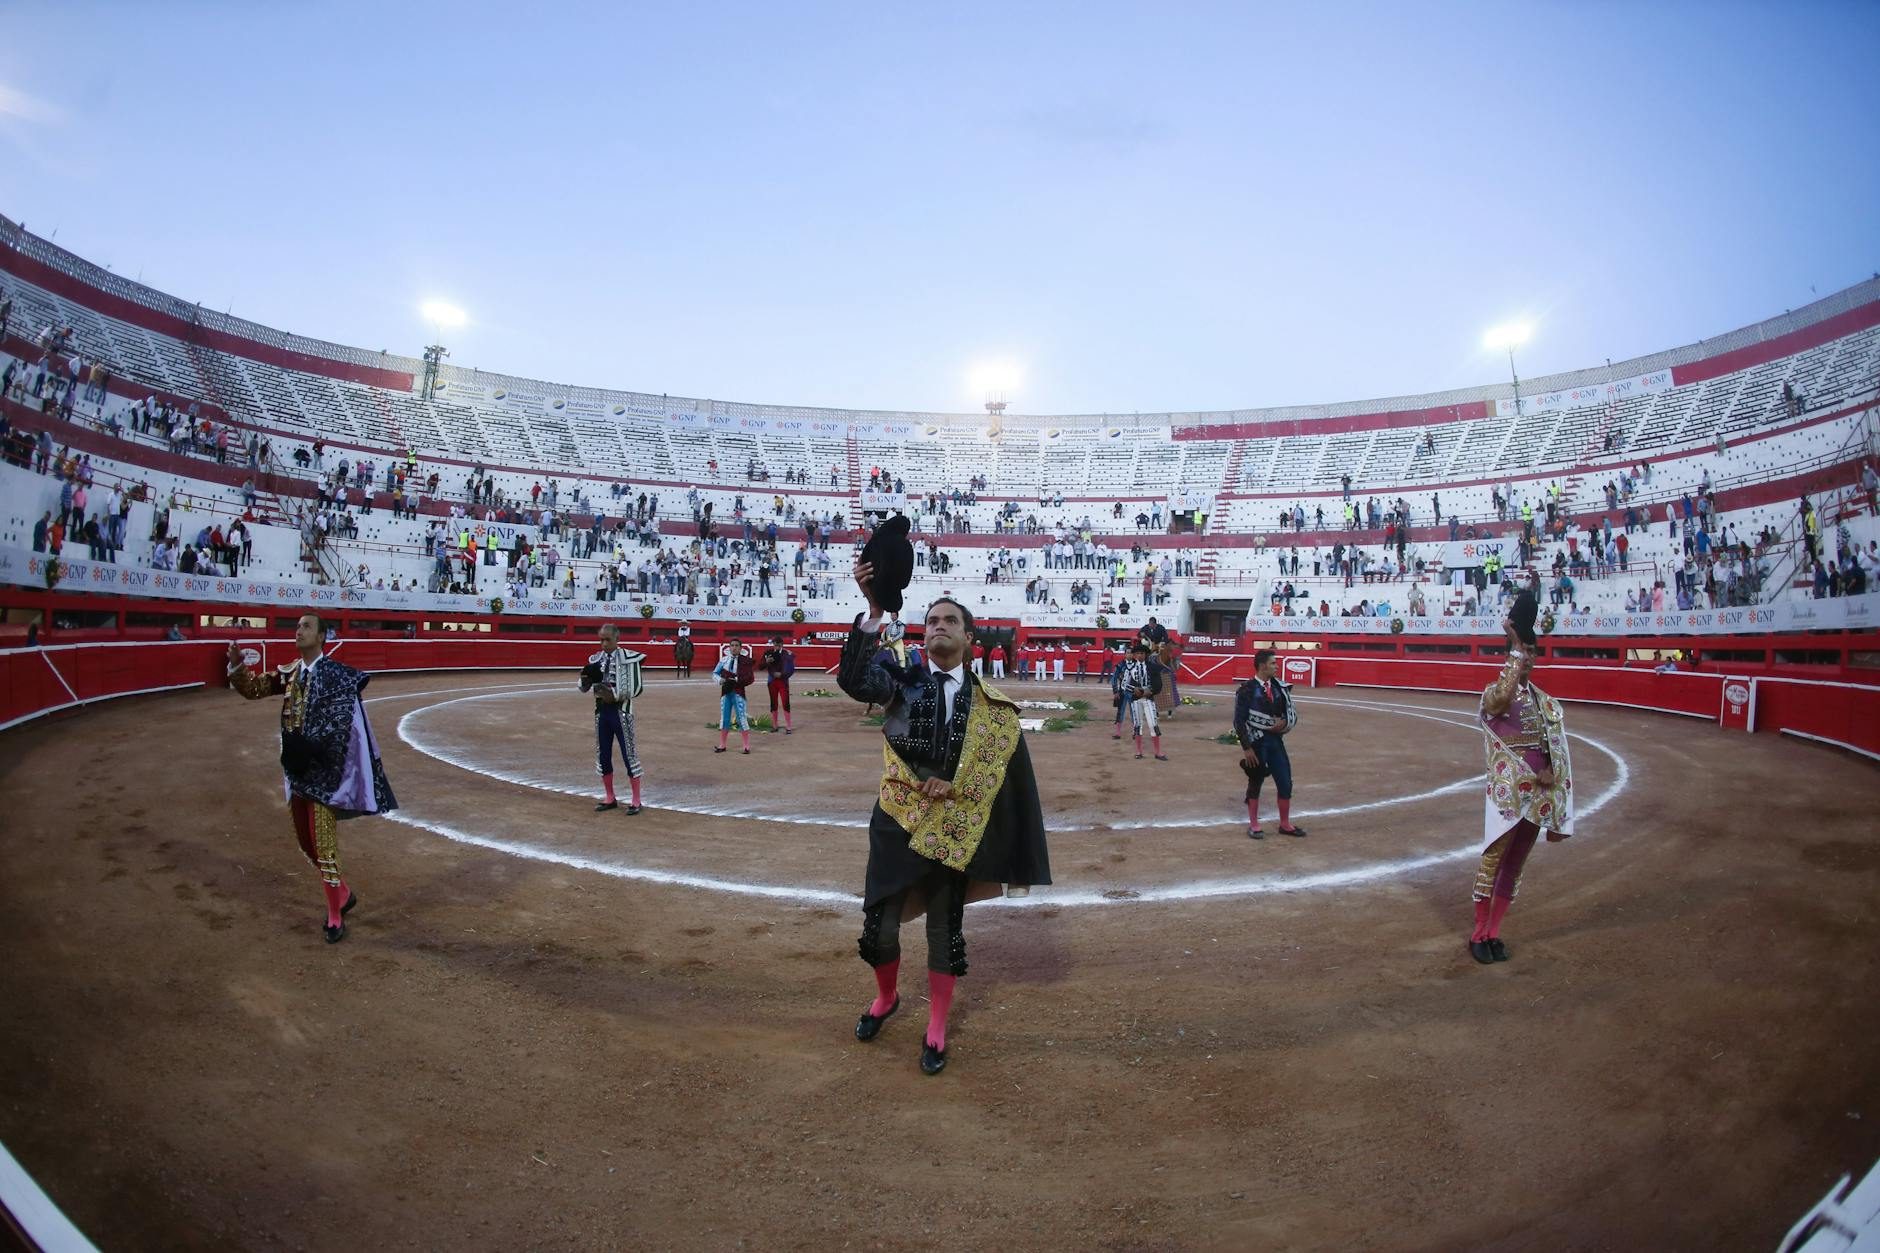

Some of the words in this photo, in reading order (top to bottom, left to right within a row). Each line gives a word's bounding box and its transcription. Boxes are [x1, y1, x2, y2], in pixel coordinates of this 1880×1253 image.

[1649, 374, 1666, 384] GNP
[1615, 382, 1632, 392] GNP
[1580, 389, 1596, 398] GNP
[1545, 395, 1561, 403] GNP
[678, 414, 696, 422] GNP
[748, 420, 766, 428] GNP
[1476, 544, 1504, 556] GNP
[69, 564, 86, 579] GNP
[101, 568, 116, 582] GNP
[130, 572, 148, 585] GNP
[162, 576, 179, 589] GNP
[192, 579, 209, 592] GNP
[225, 582, 242, 594] GNP
[255, 585, 272, 596] GNP
[286, 587, 303, 598] GNP
[318, 589, 335, 600] GNP
[348, 591, 366, 601] GNP
[515, 600, 533, 608] GNP
[548, 601, 565, 610] GNP
[579, 603, 596, 611] GNP
[611, 604, 628, 612] GNP
[674, 607, 692, 615] GNP
[1757, 610, 1775, 622] GNP
[1571, 619, 1588, 627] GNP
[1602, 618, 1619, 627] GNP
[1633, 617, 1650, 626] GNP
[1664, 616, 1682, 626] GNP
[1696, 614, 1712, 626] GNP
[1726, 612, 1743, 624] GNP
